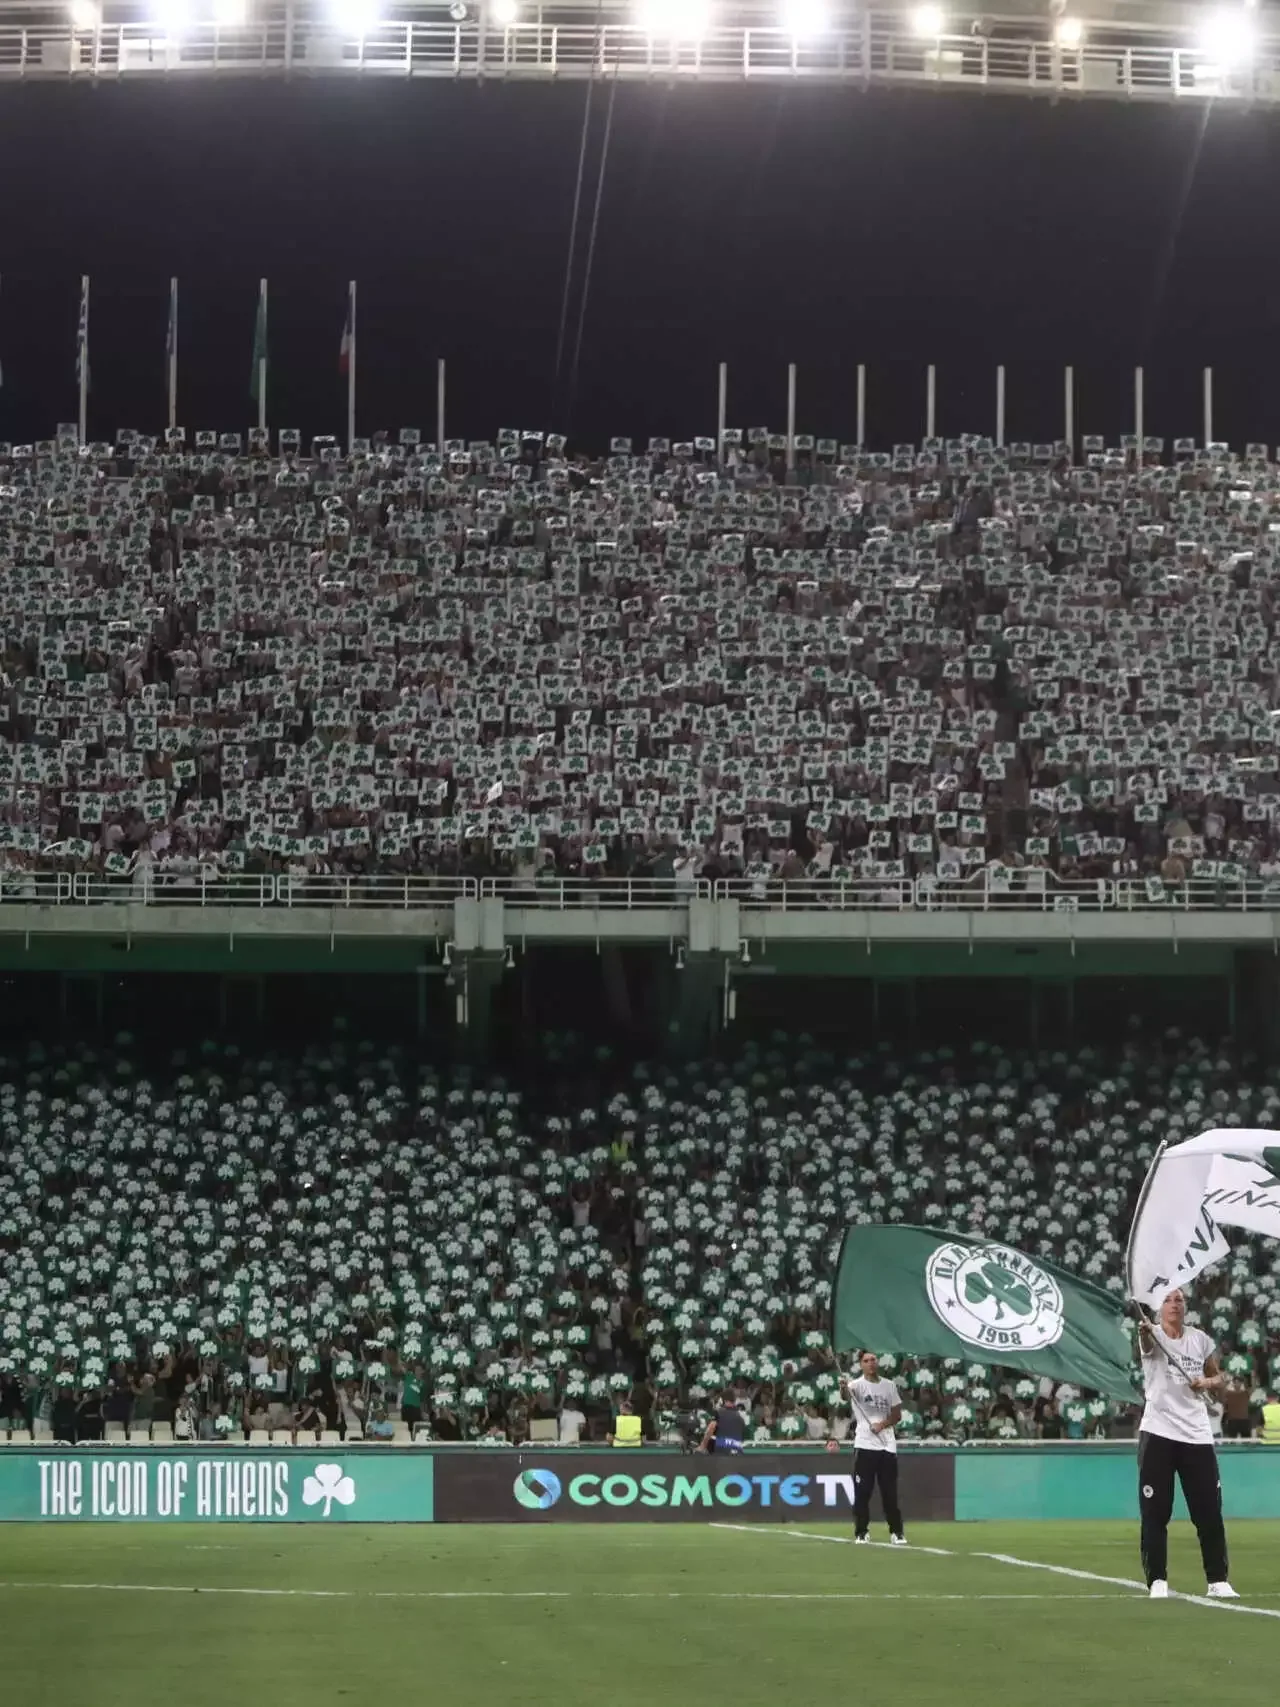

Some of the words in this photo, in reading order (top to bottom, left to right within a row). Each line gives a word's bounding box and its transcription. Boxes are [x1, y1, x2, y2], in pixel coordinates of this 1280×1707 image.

[976, 1323, 1023, 1345] 1908
[38, 1460, 83, 1516] THE
[92, 1460, 148, 1516] ICON
[157, 1460, 188, 1516] OF
[196, 1460, 289, 1516] ATHENS
[568, 1473, 810, 1508] COSMOTE
